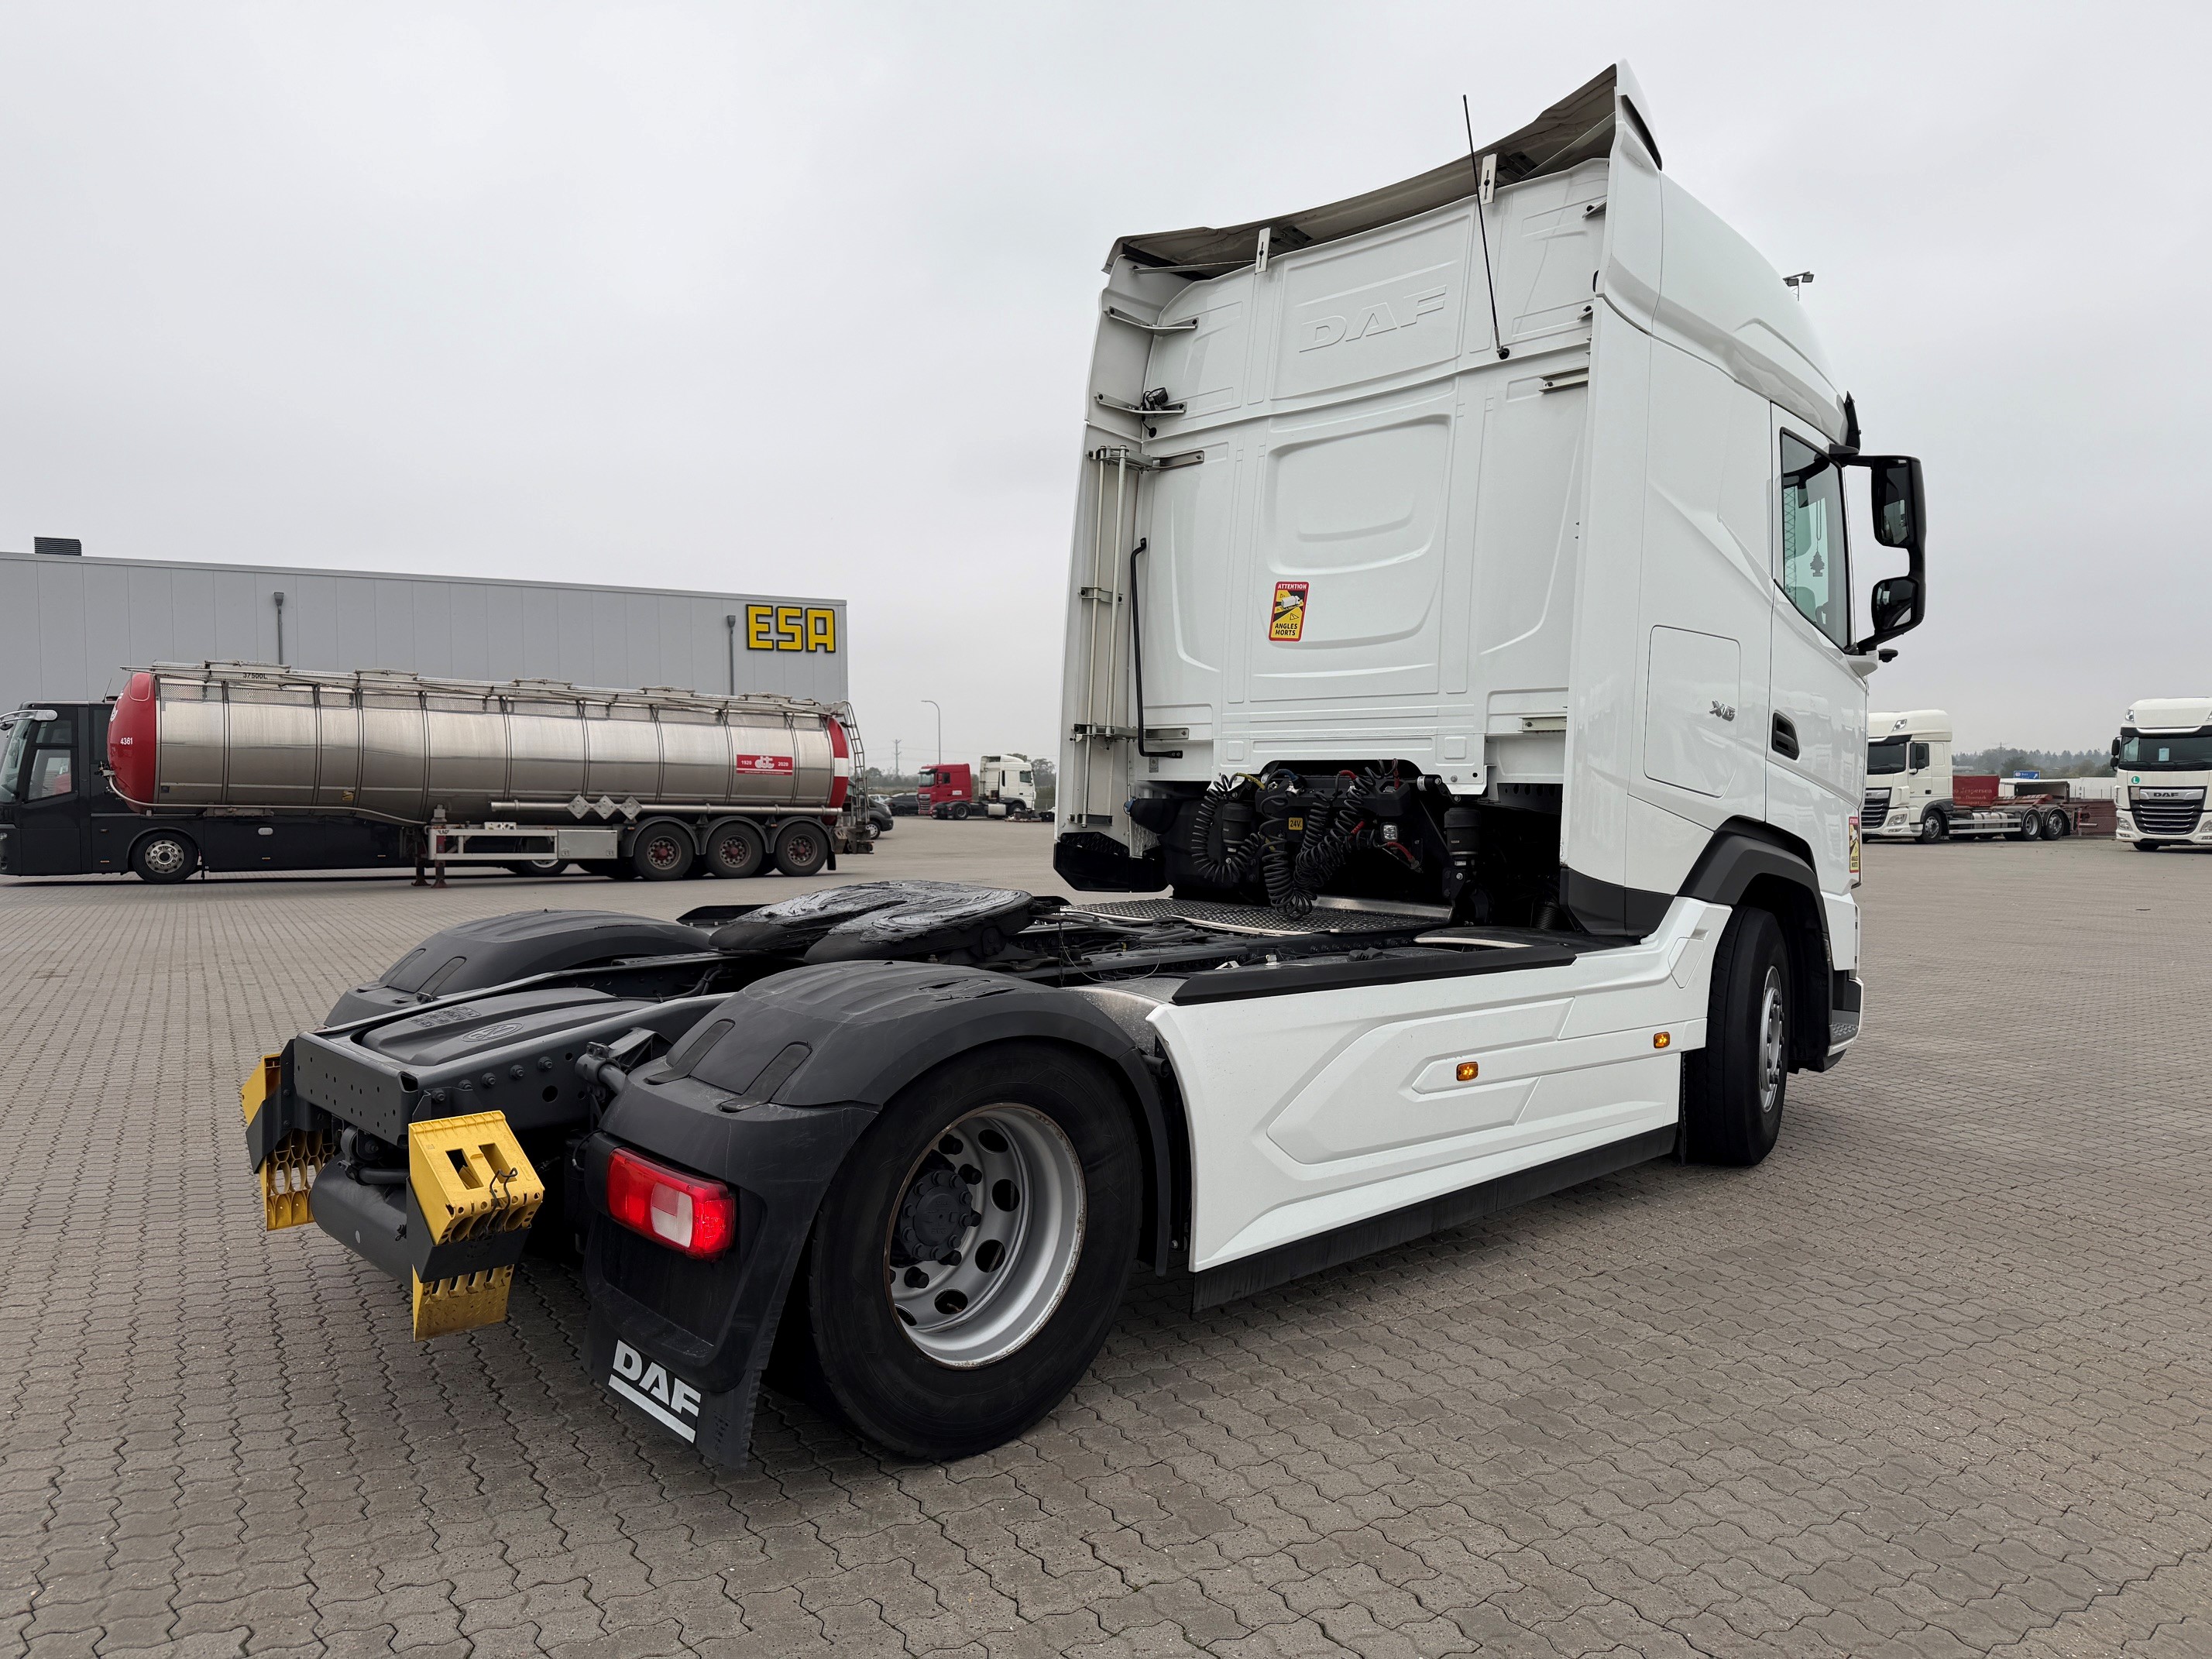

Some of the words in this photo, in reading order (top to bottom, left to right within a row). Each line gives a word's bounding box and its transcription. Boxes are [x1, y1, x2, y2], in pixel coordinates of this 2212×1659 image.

[1299, 284, 1447, 352] DAF
[746, 604, 836, 653] ESA
[1709, 699, 1736, 722] XG
[613, 1339, 702, 1417] DAF
